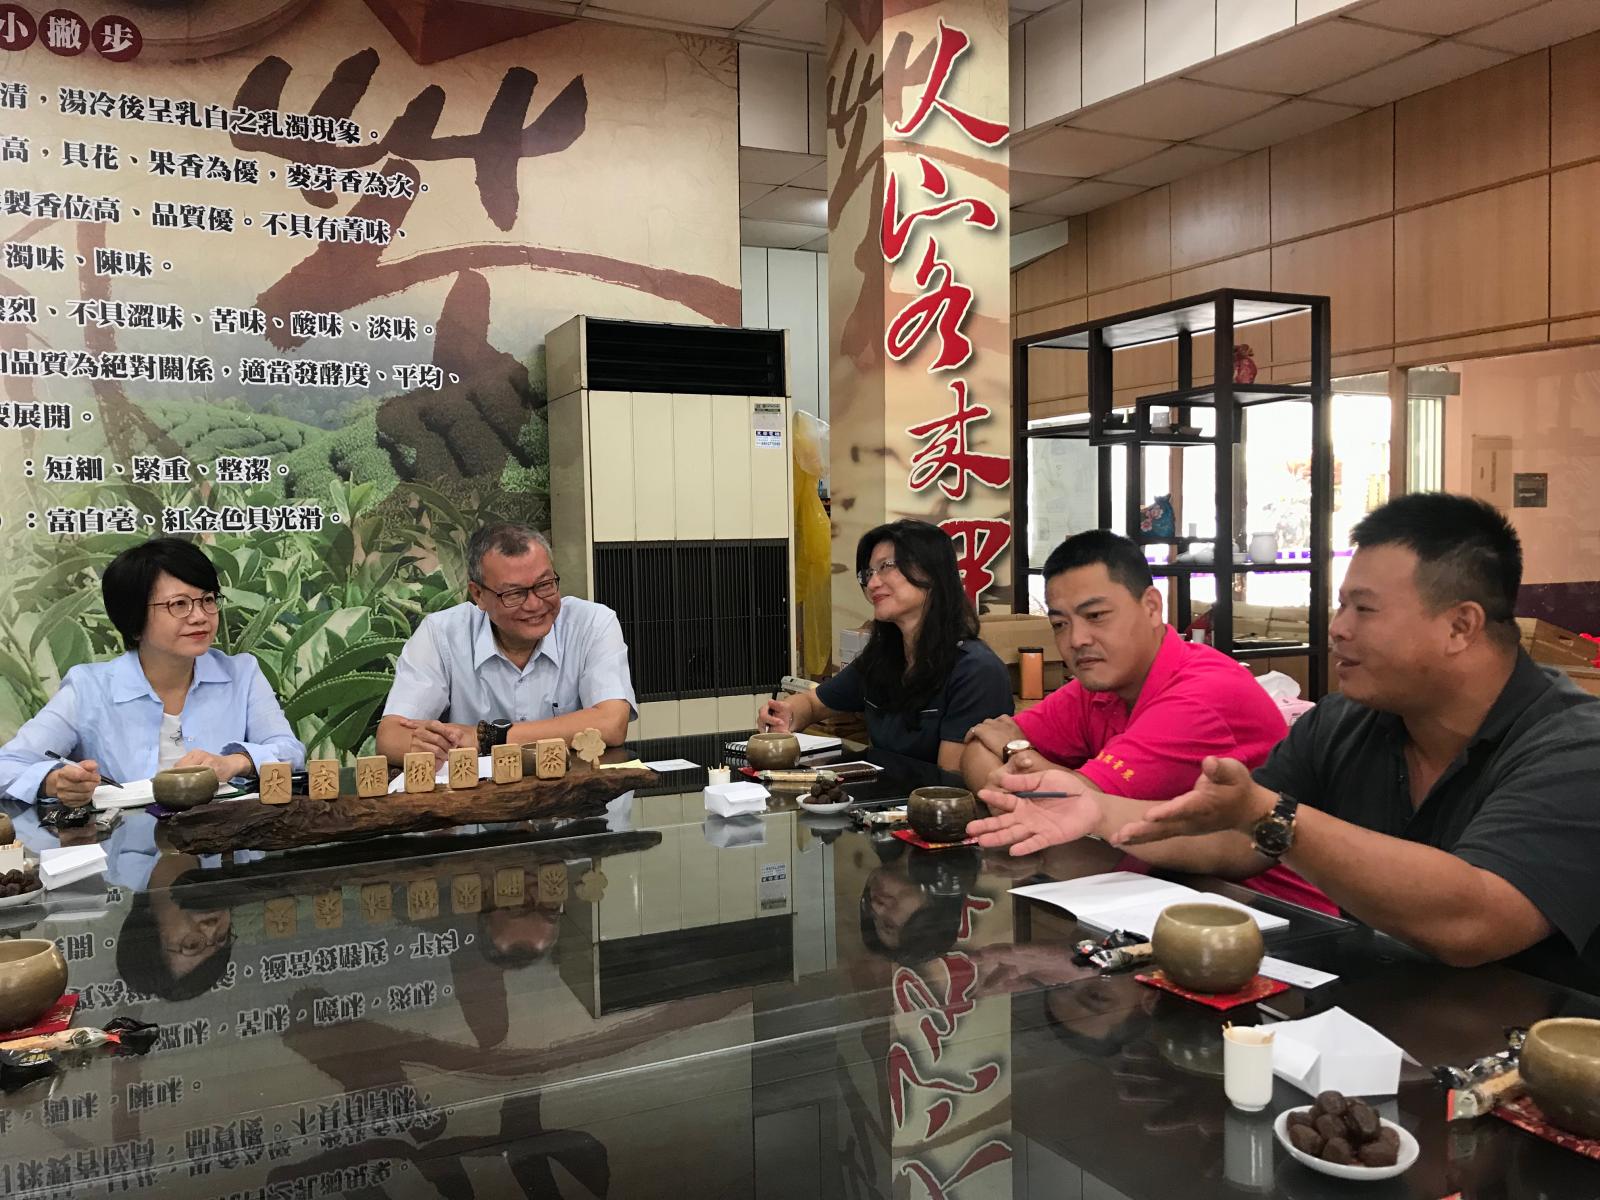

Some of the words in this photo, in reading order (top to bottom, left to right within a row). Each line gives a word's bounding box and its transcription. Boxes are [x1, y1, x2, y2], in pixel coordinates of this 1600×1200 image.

[0, 11, 134, 53] 小撇步
[6, 243, 173, 278] 濁味、陳味。
[0, 297, 435, 341] 烈、不具澀味、苦味、酸味、淡味。
